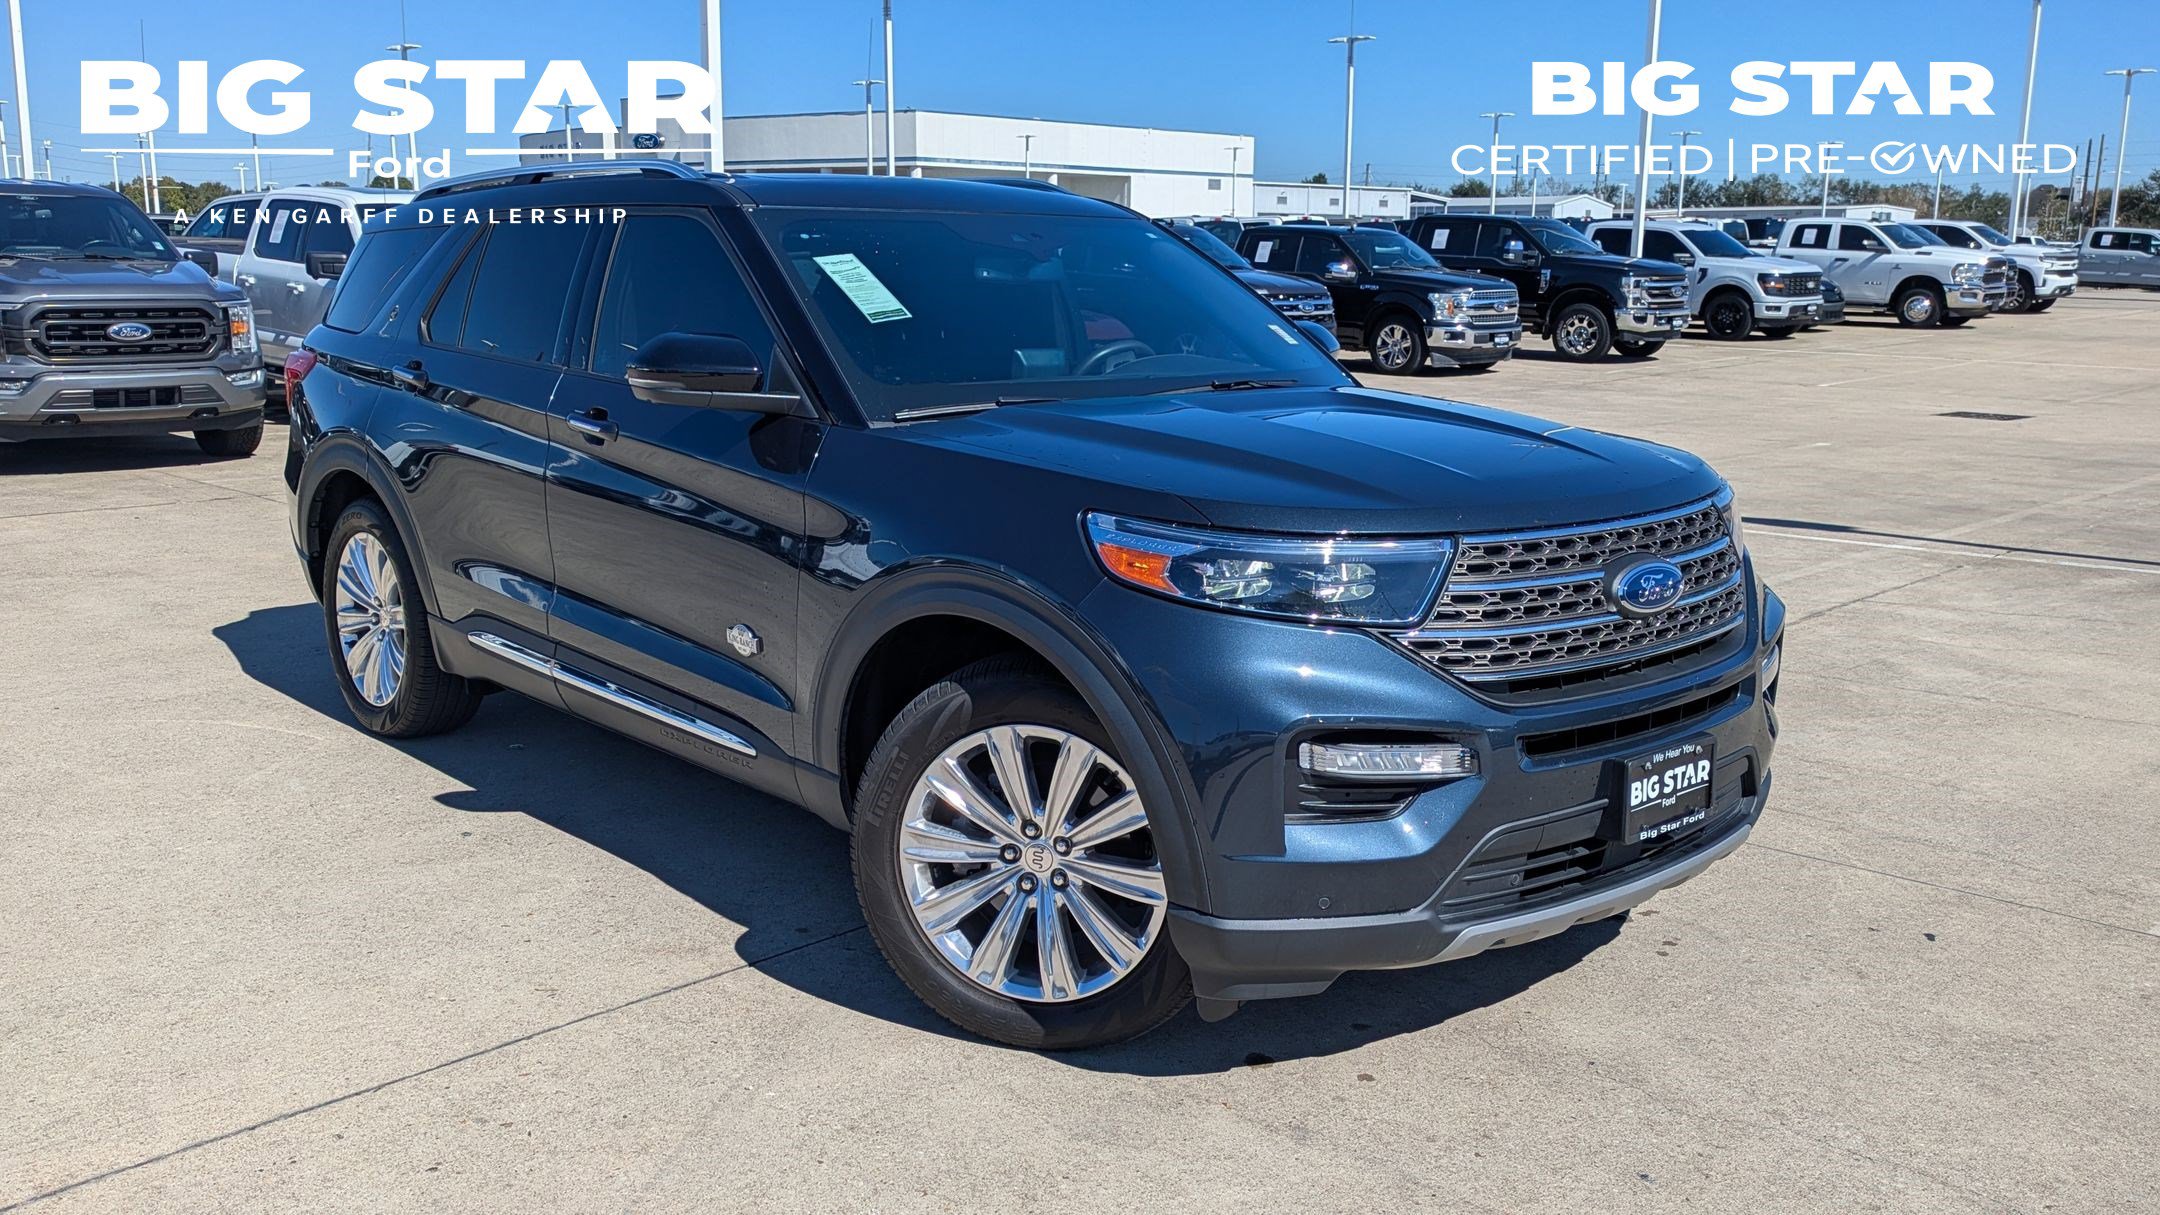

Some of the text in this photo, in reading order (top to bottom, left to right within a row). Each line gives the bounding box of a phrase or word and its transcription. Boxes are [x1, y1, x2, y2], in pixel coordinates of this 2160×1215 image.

[1638, 573, 1674, 602] Ford
[1652, 744, 1696, 764] We Hear You
[863, 745, 910, 828] PIRELLI
[1630, 759, 1711, 807] BIG STAR
[1662, 795, 1676, 808] Ford
[1640, 810, 1705, 840] Big Star Ford
